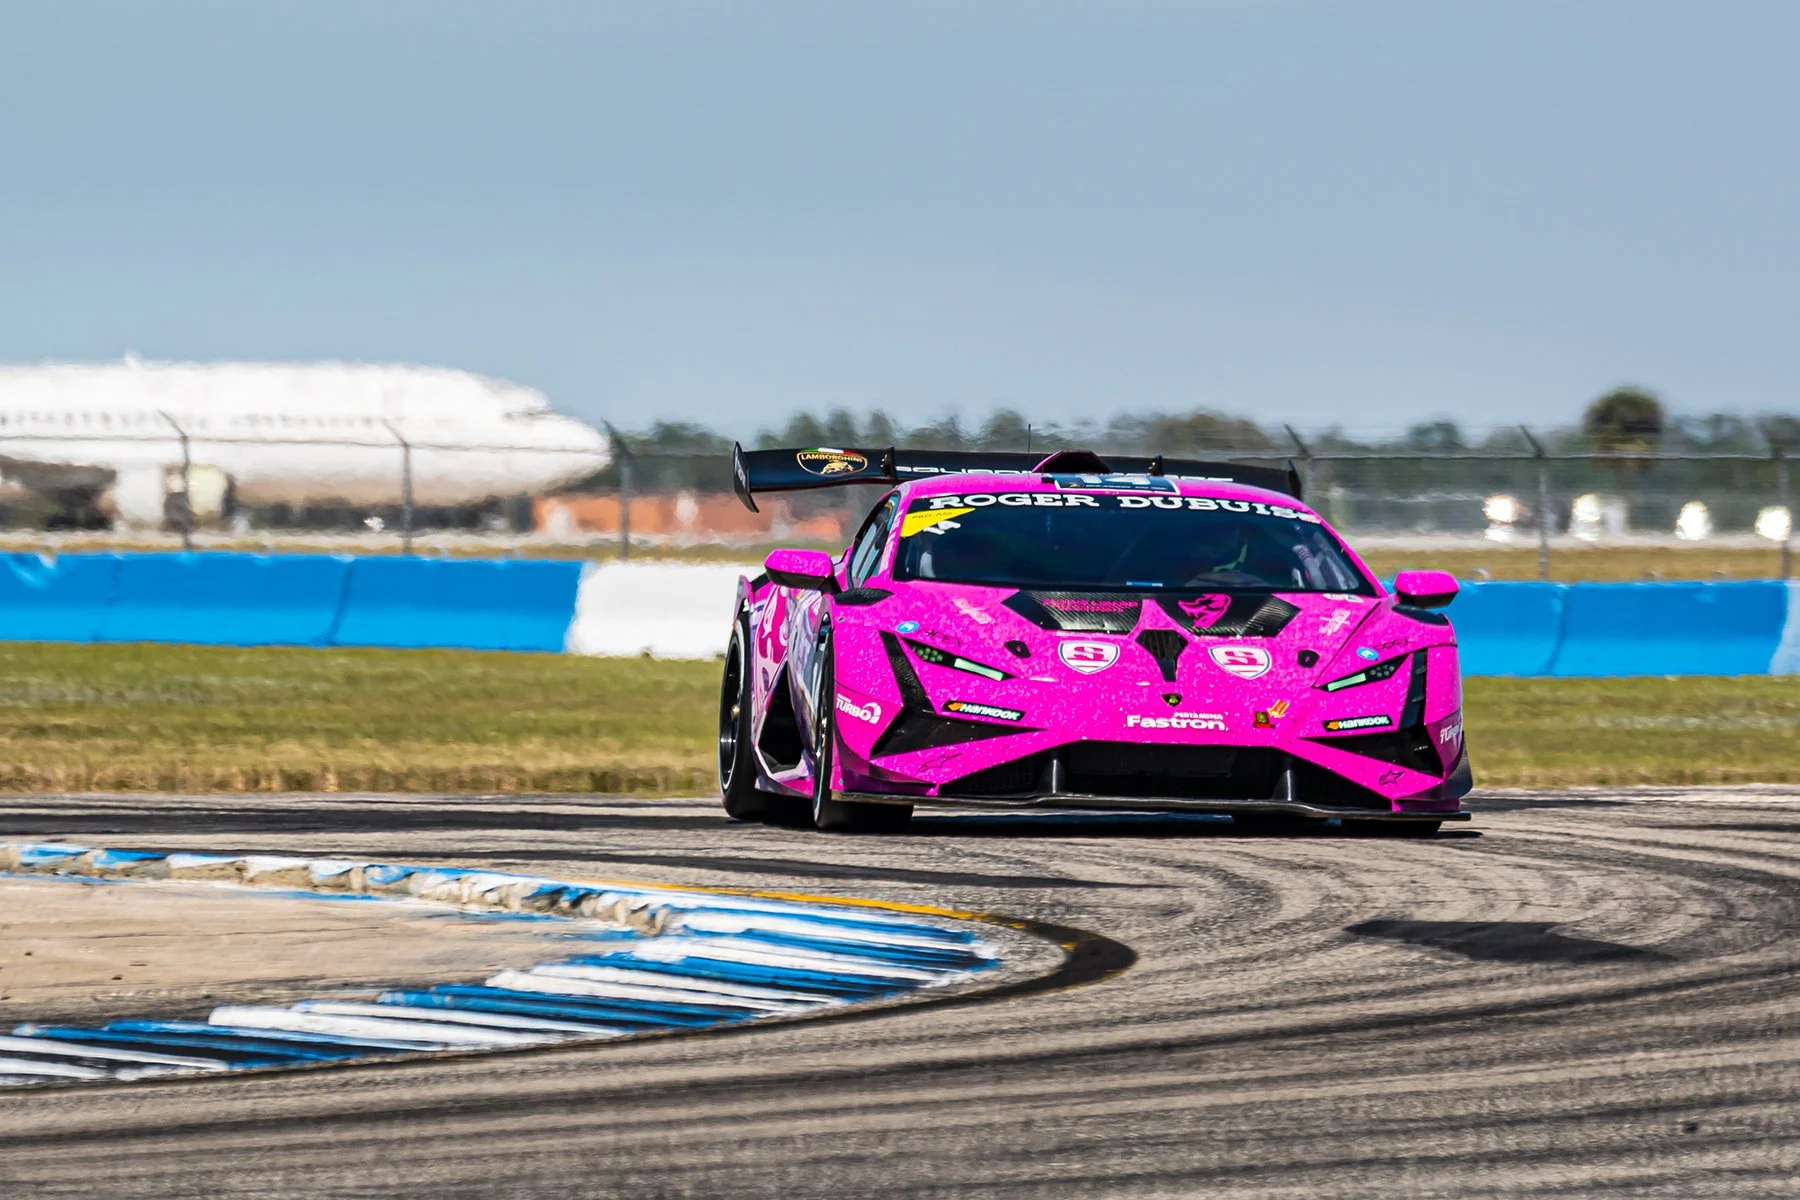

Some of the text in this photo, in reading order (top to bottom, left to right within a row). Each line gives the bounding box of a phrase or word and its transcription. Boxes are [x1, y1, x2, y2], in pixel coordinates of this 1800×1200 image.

[801, 453, 862, 462] LAMBORGHINI
[929, 494, 1099, 509] ROGER
[1117, 497, 1297, 519] DUBUIS
[836, 697, 872, 722] TURBO
[1173, 711, 1223, 720] PERTAMINA
[1126, 714, 1225, 731] Fastron
